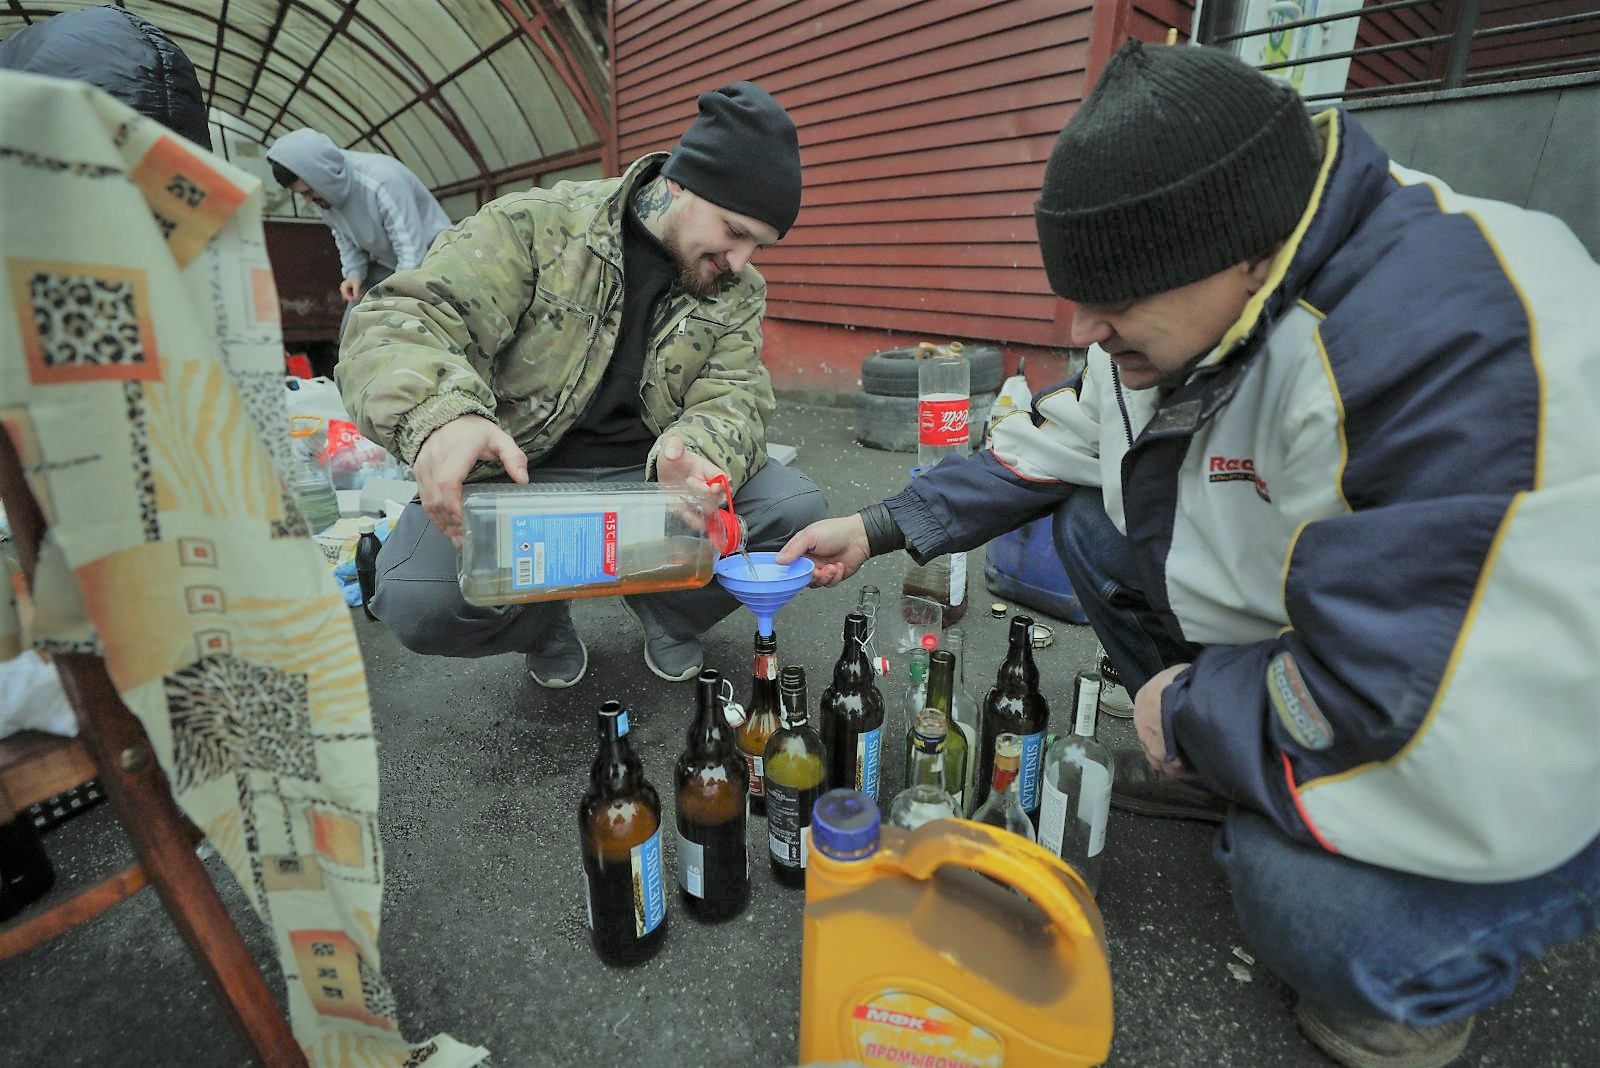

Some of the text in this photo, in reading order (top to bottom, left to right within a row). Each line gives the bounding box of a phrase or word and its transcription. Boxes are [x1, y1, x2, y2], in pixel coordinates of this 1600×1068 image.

[1273, 659, 1319, 743] Reebok
[646, 847, 662, 927] KVIETINIS
[866, 1008, 926, 1031] МФК
